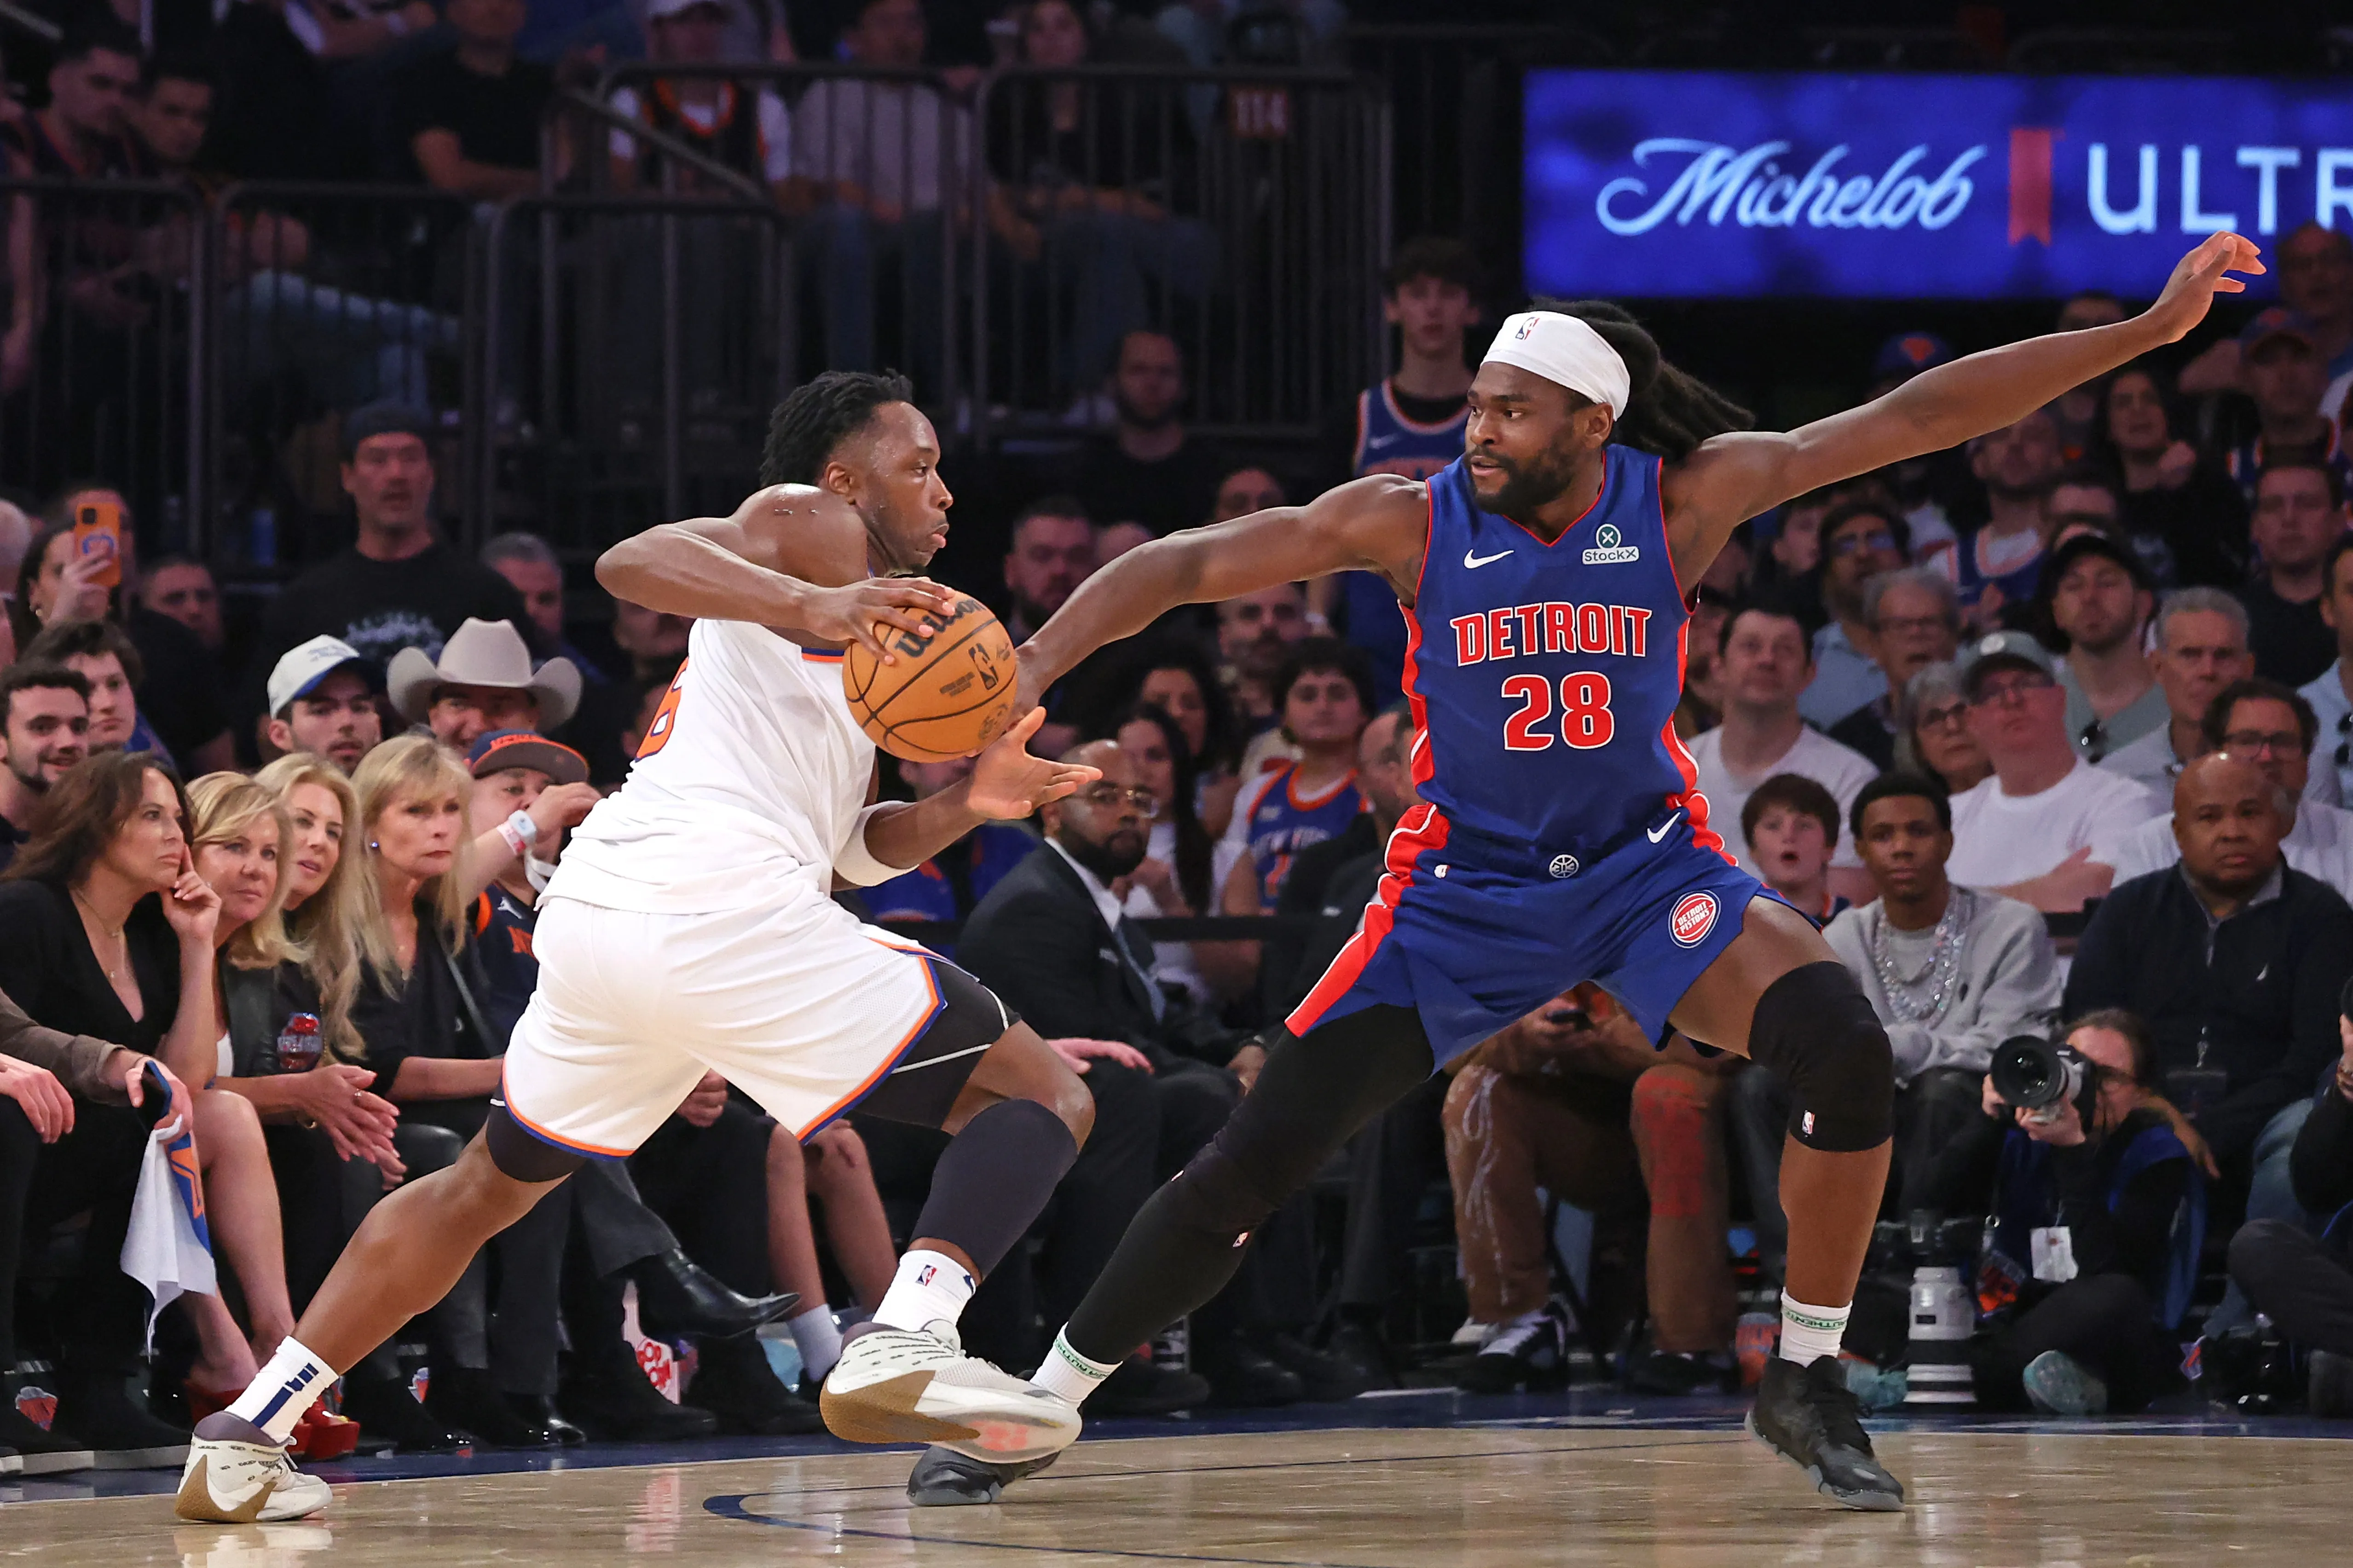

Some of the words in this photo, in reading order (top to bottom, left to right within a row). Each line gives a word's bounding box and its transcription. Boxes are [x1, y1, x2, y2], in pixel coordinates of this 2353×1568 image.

[1595, 137, 1988, 236] Michelob
[1584, 548, 1637, 562] StockX
[1450, 601, 1653, 667] DETROIT
[1501, 671, 1615, 751] 28
[1677, 901, 1707, 926] DETROIT
[1680, 908, 1710, 934] PISTONS
